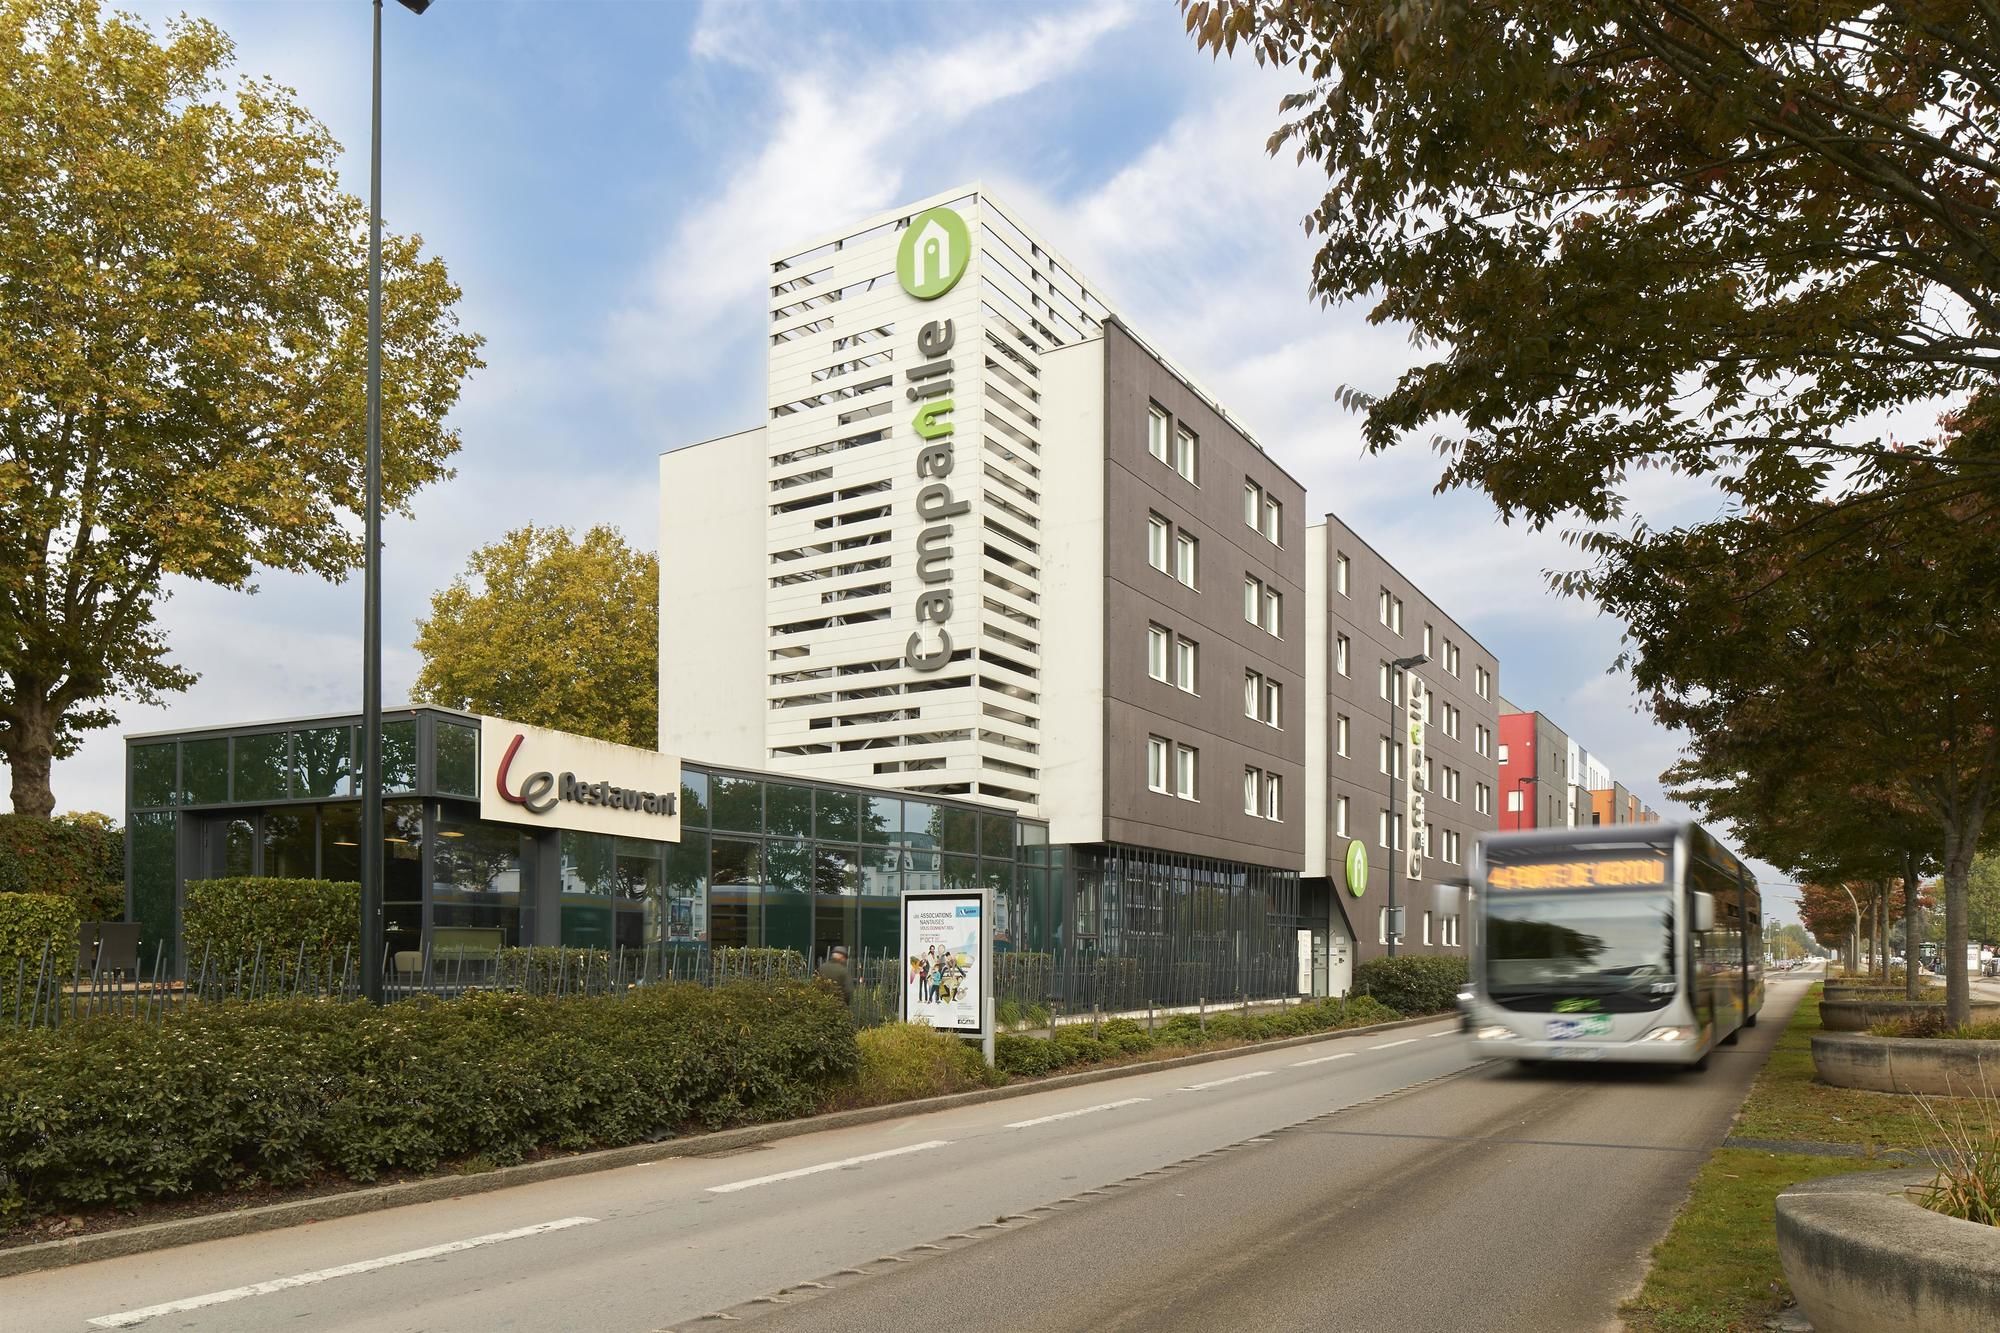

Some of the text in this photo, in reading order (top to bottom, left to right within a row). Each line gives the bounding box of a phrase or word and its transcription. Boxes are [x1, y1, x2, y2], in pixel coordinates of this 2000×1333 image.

[905, 317, 971, 672] Campanile
[496, 734, 677, 817] Le Restaurant
